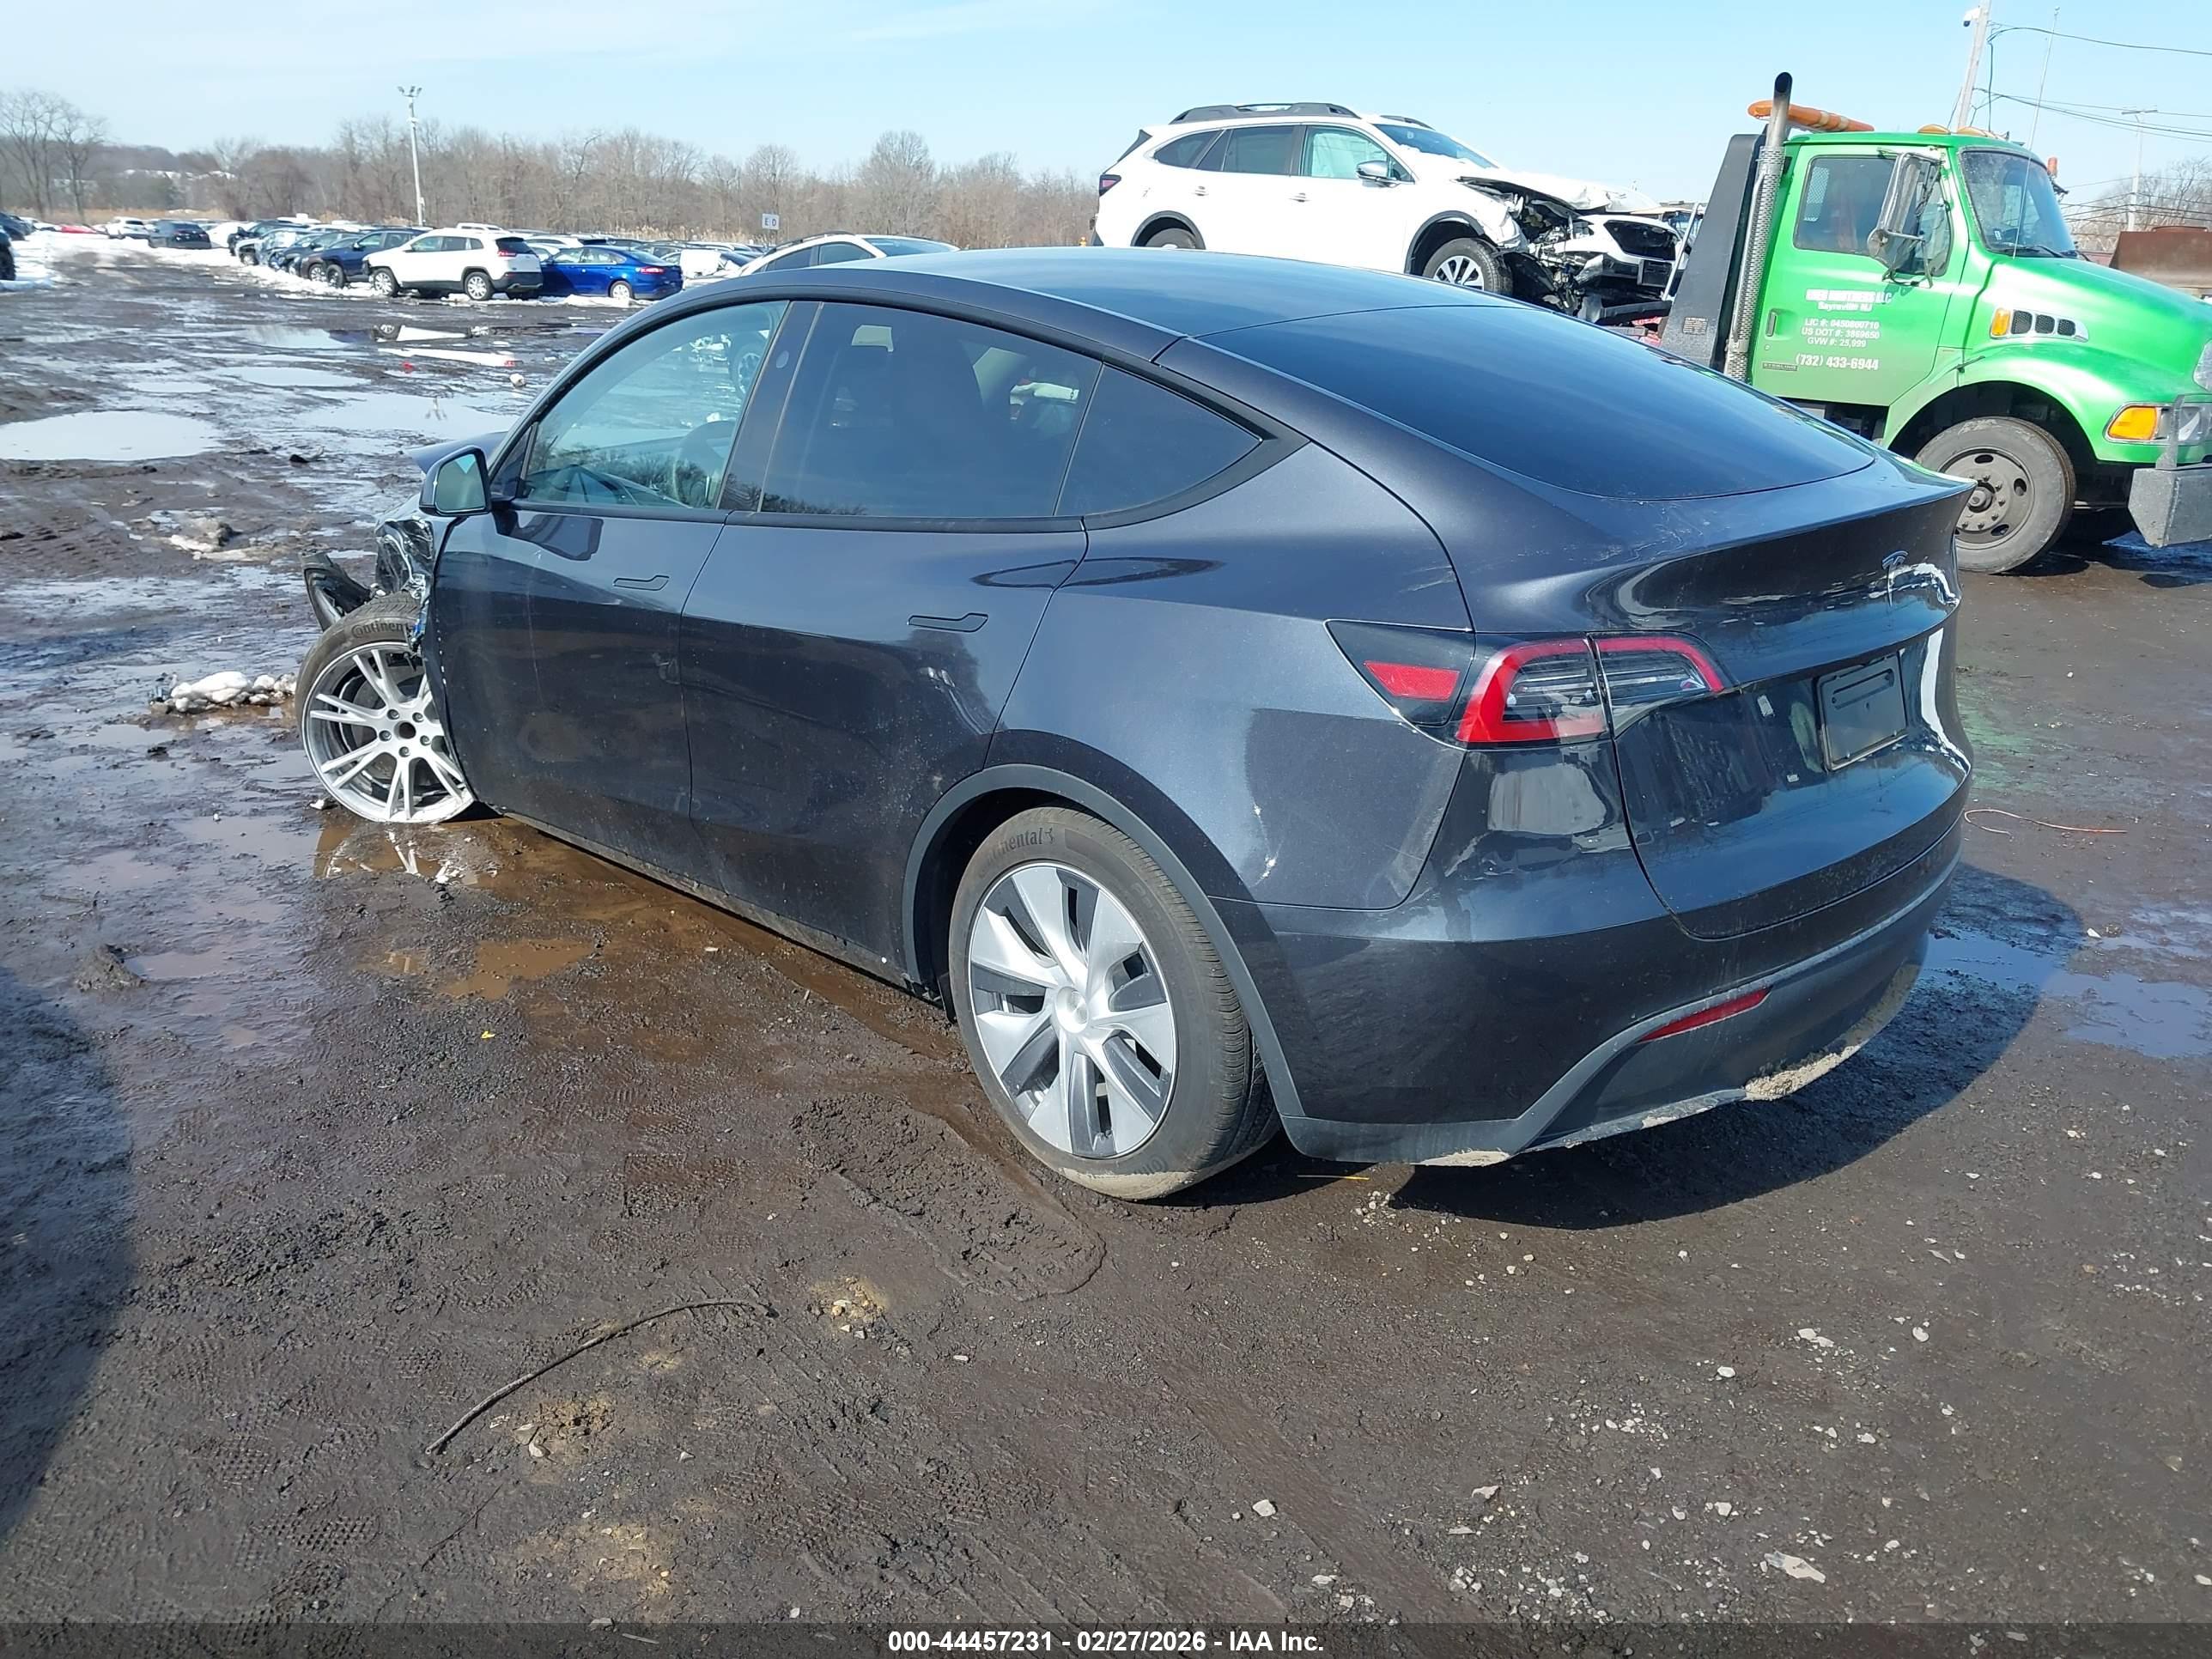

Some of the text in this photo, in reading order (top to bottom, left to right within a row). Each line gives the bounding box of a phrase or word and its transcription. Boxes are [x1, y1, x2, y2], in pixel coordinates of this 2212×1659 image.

[1801, 326, 1814, 336] US
[1815, 328, 1834, 337] DOT
[1807, 337, 1828, 345] GVW
[1796, 353, 1880, 371] (732) 433-6944
